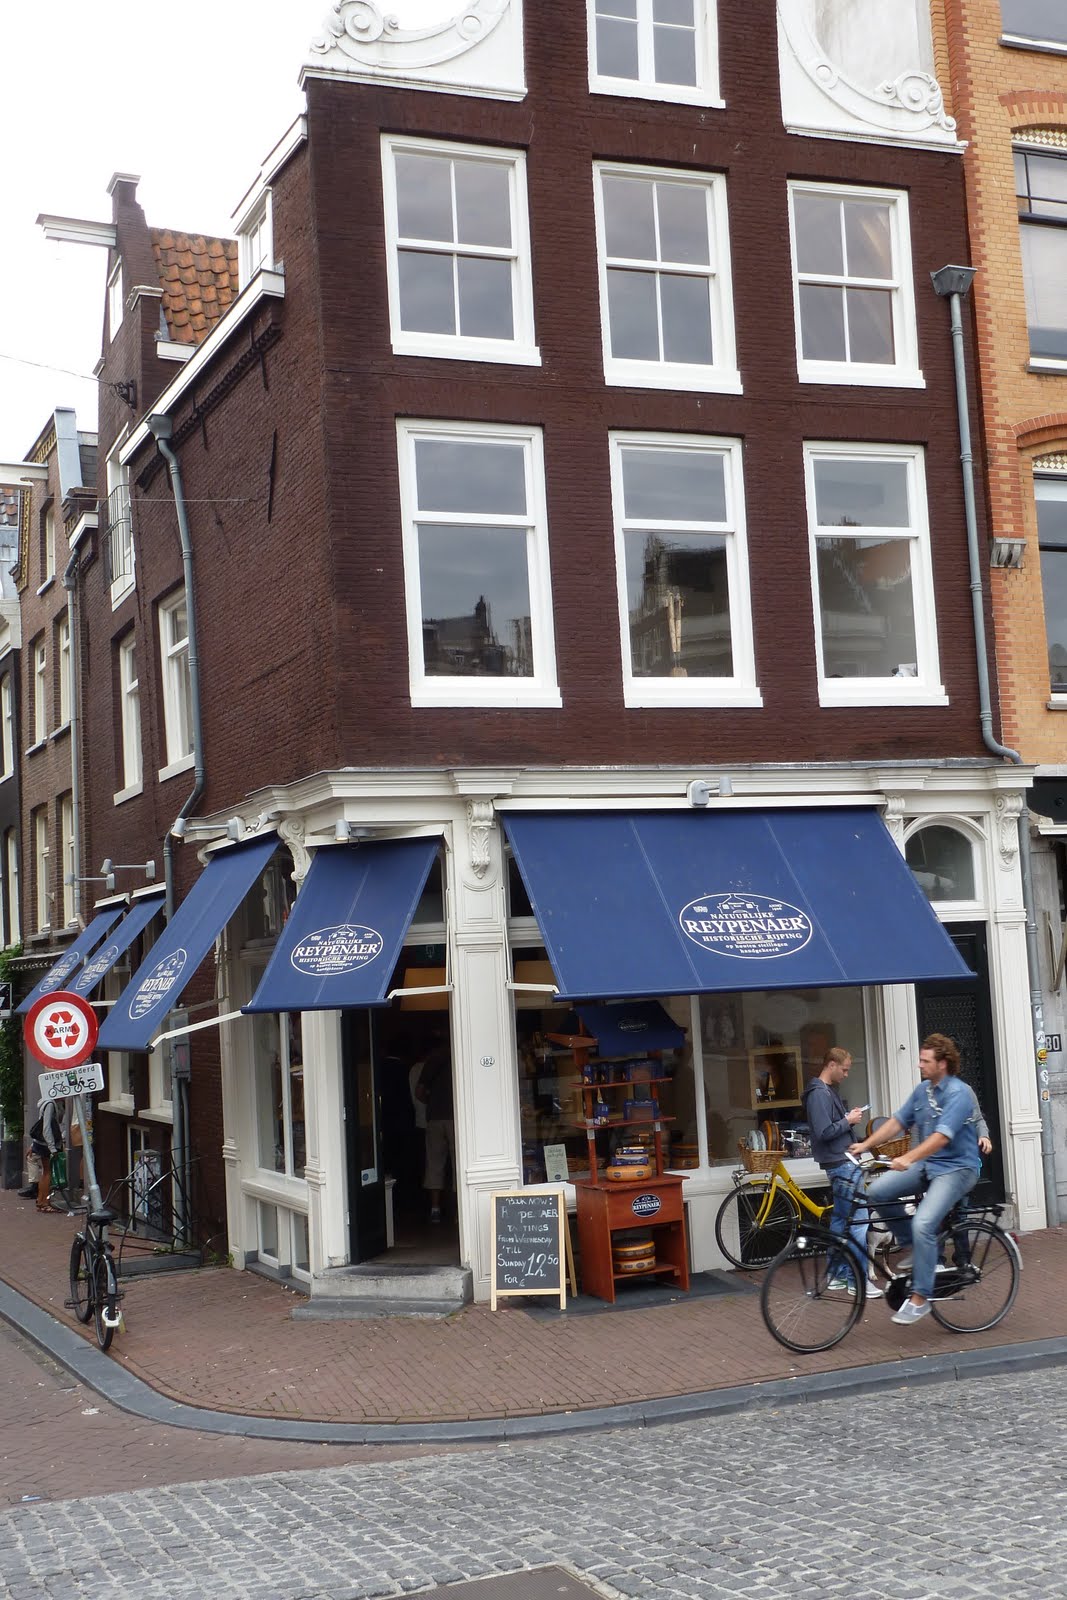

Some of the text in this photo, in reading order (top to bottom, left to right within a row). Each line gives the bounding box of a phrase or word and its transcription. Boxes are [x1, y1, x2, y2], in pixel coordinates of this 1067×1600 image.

[710, 912, 774, 920] NATUURLIJKE
[684, 916, 808, 934] REYPENAER
[702, 932, 803, 942] HISTORISCHE RIJPING
[294, 943, 378, 958] REYPENAER
[47, 1025, 78, 1035] KARMA
[507, 1224, 549, 1232] TATINGS
[504, 1273, 518, 1284] FOR
